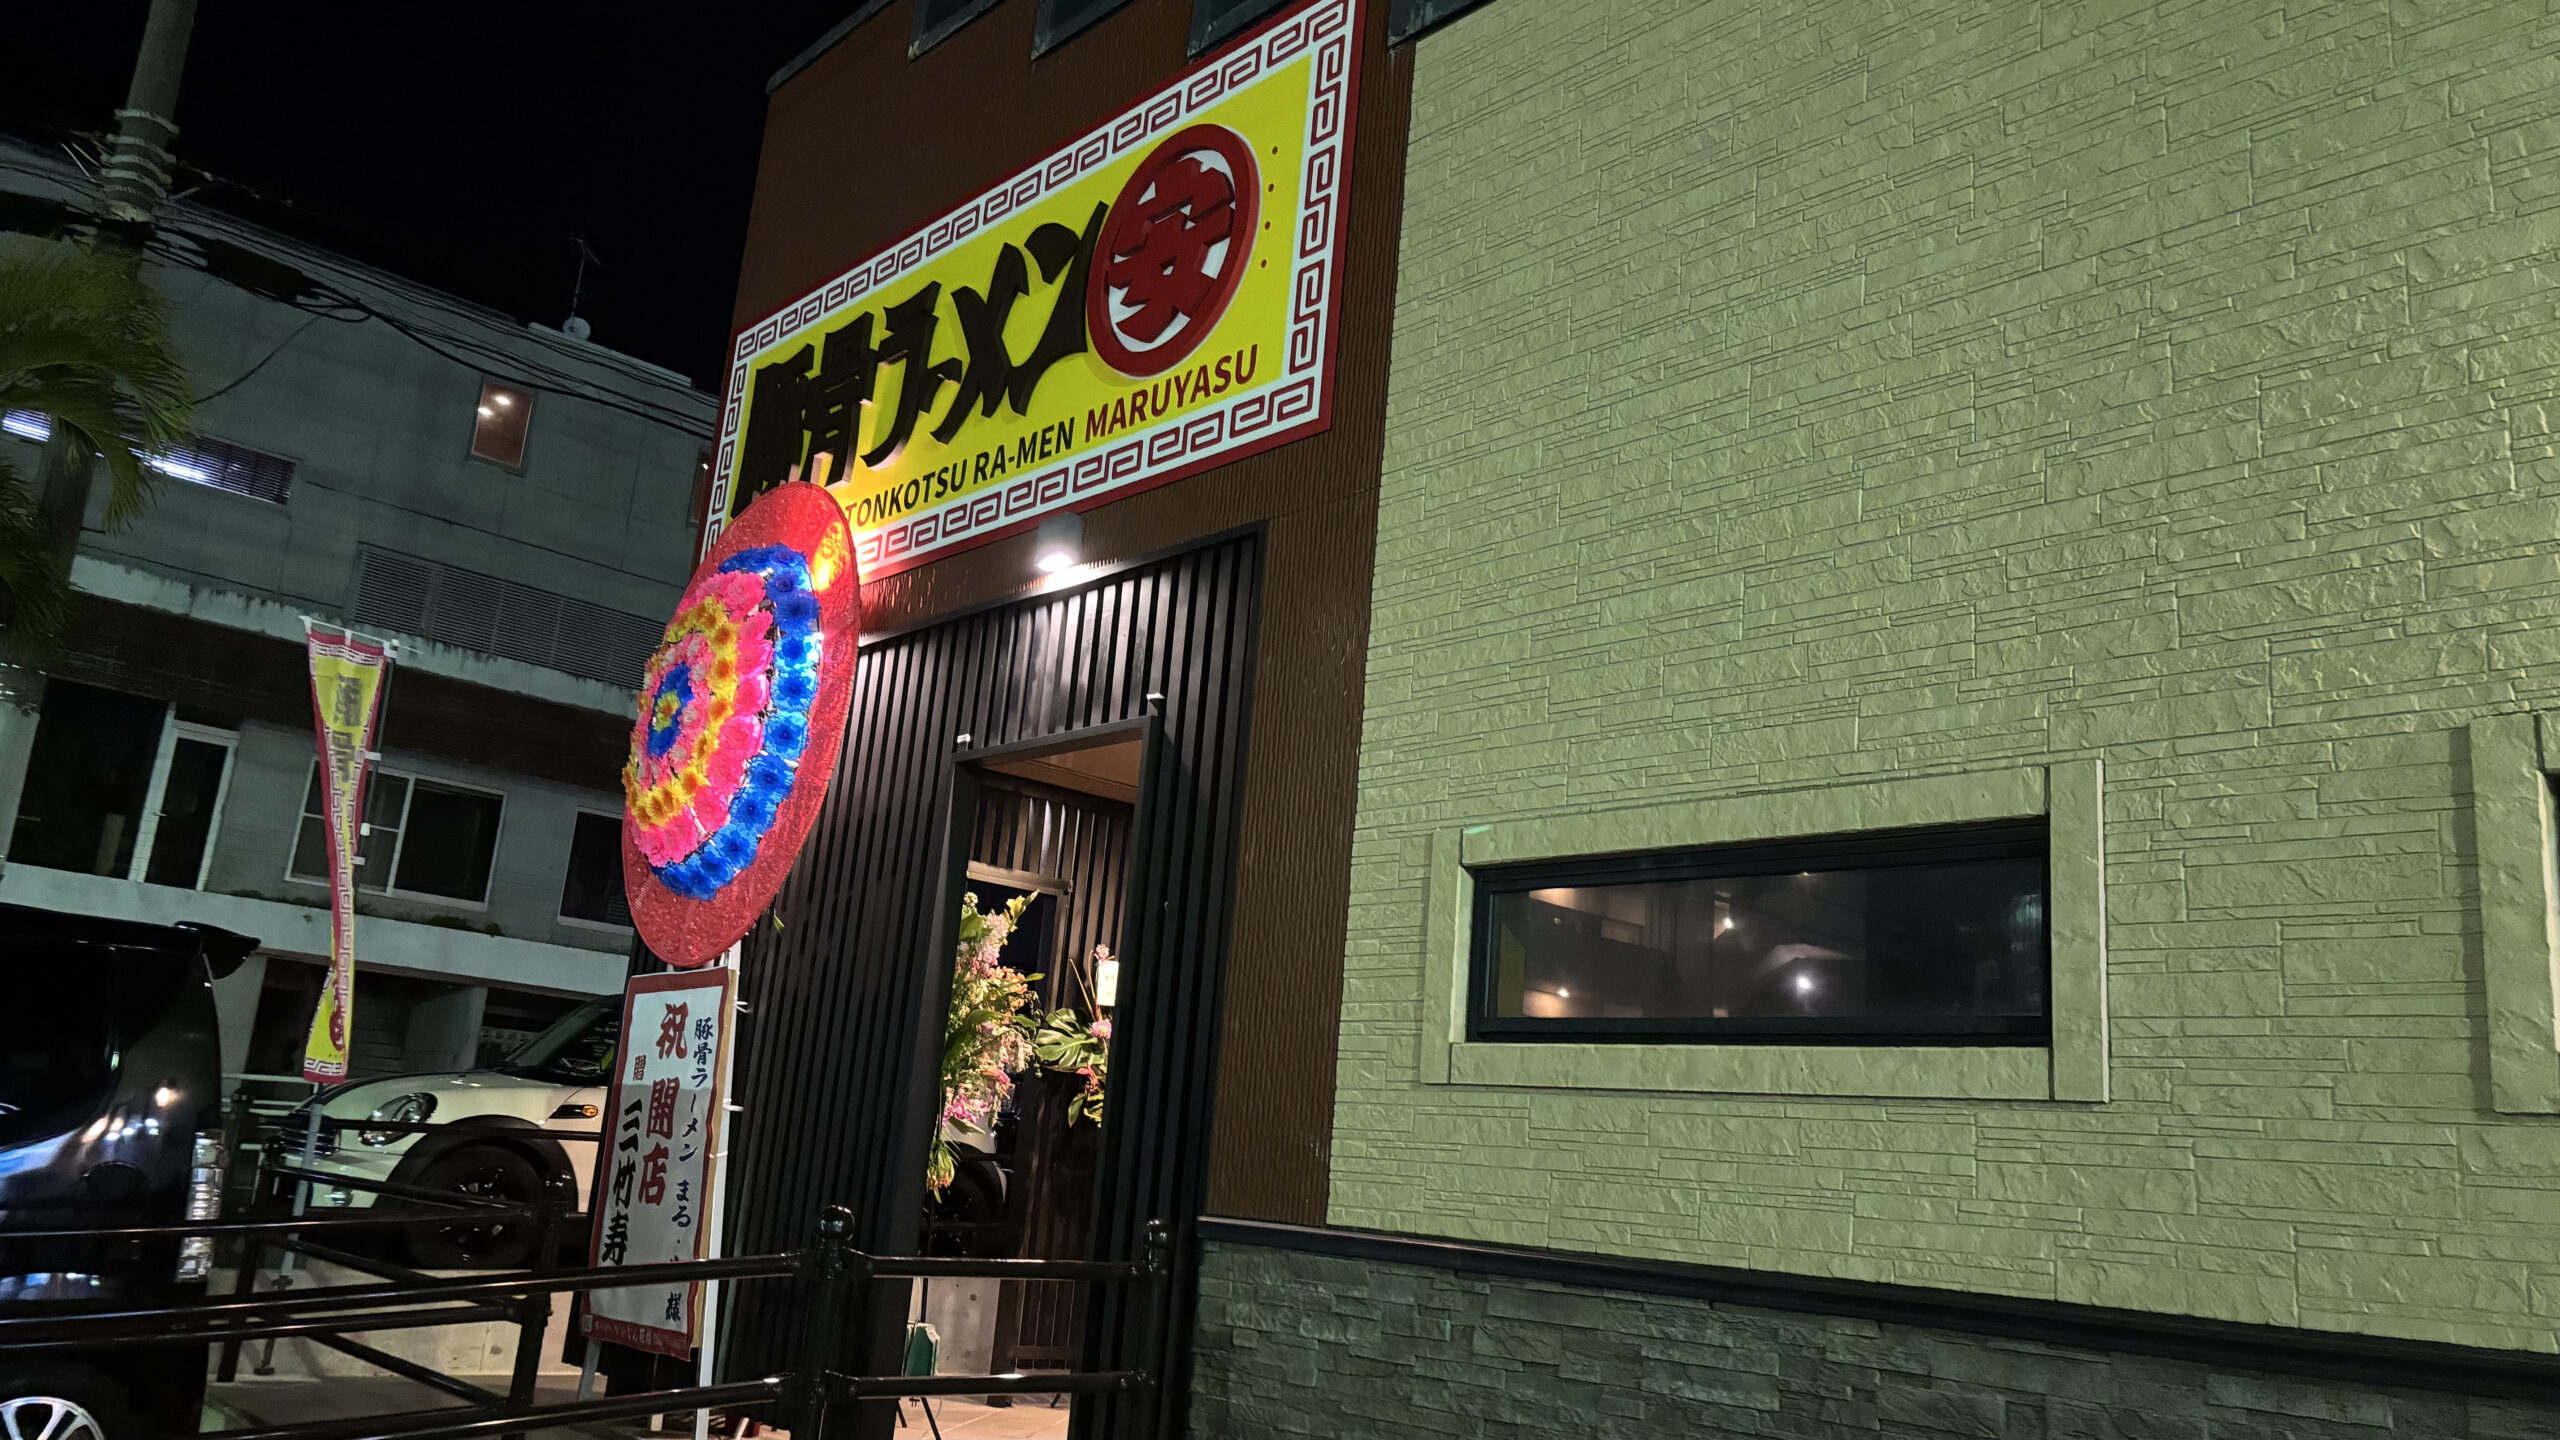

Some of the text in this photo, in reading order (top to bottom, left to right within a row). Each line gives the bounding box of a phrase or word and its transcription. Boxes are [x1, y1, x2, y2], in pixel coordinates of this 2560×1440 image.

[846, 344, 1258, 527] TONKOTSU RA-MEN MARUYASU
[639, 1002, 688, 1206] 祝 開店
[679, 1017, 714, 1162] 豚骨ラーメン
[670, 1180, 692, 1262] まる・
